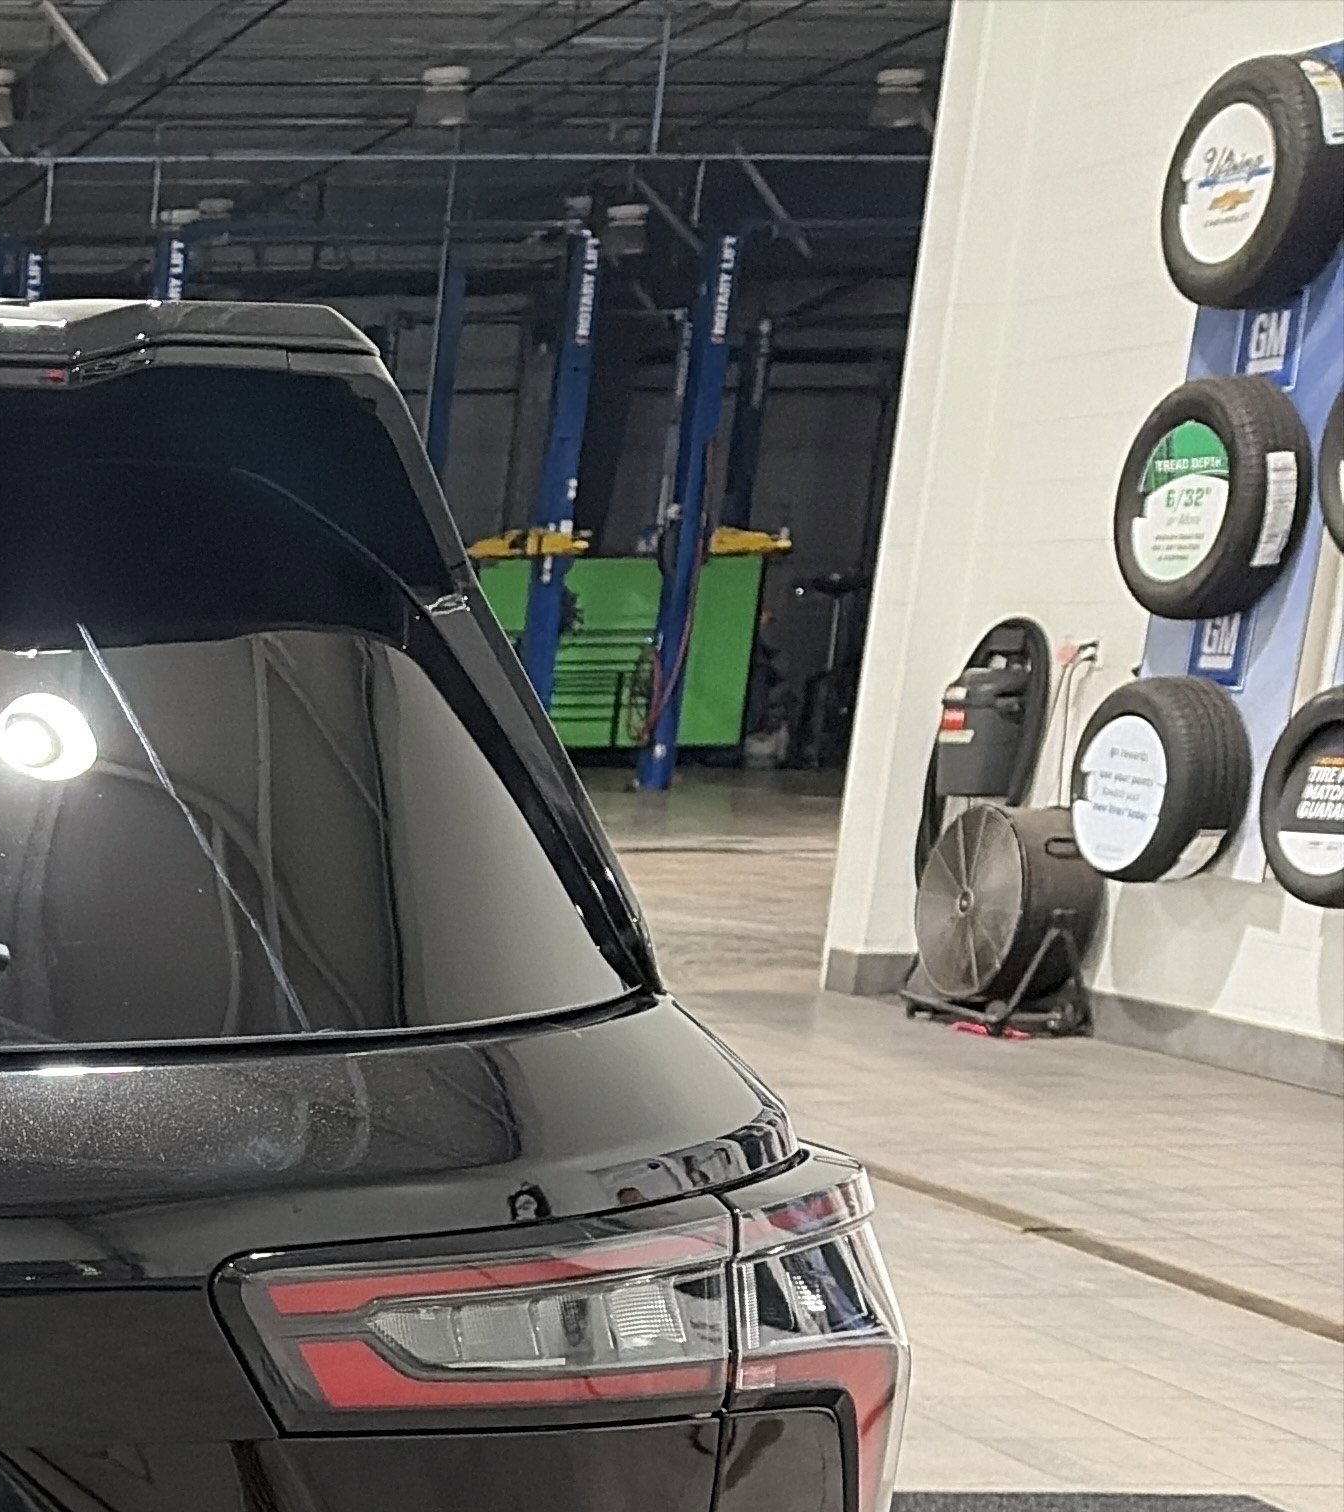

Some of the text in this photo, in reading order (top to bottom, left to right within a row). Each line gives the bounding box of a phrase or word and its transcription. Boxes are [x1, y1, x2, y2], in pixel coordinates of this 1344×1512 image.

[1248, 310, 1292, 361] GM
[1155, 456, 1222, 474] TREAD DEPTH
[1200, 612, 1242, 655] GM
[1308, 766, 1336, 784] TIRE
[1297, 801, 1344, 820] GUARA
